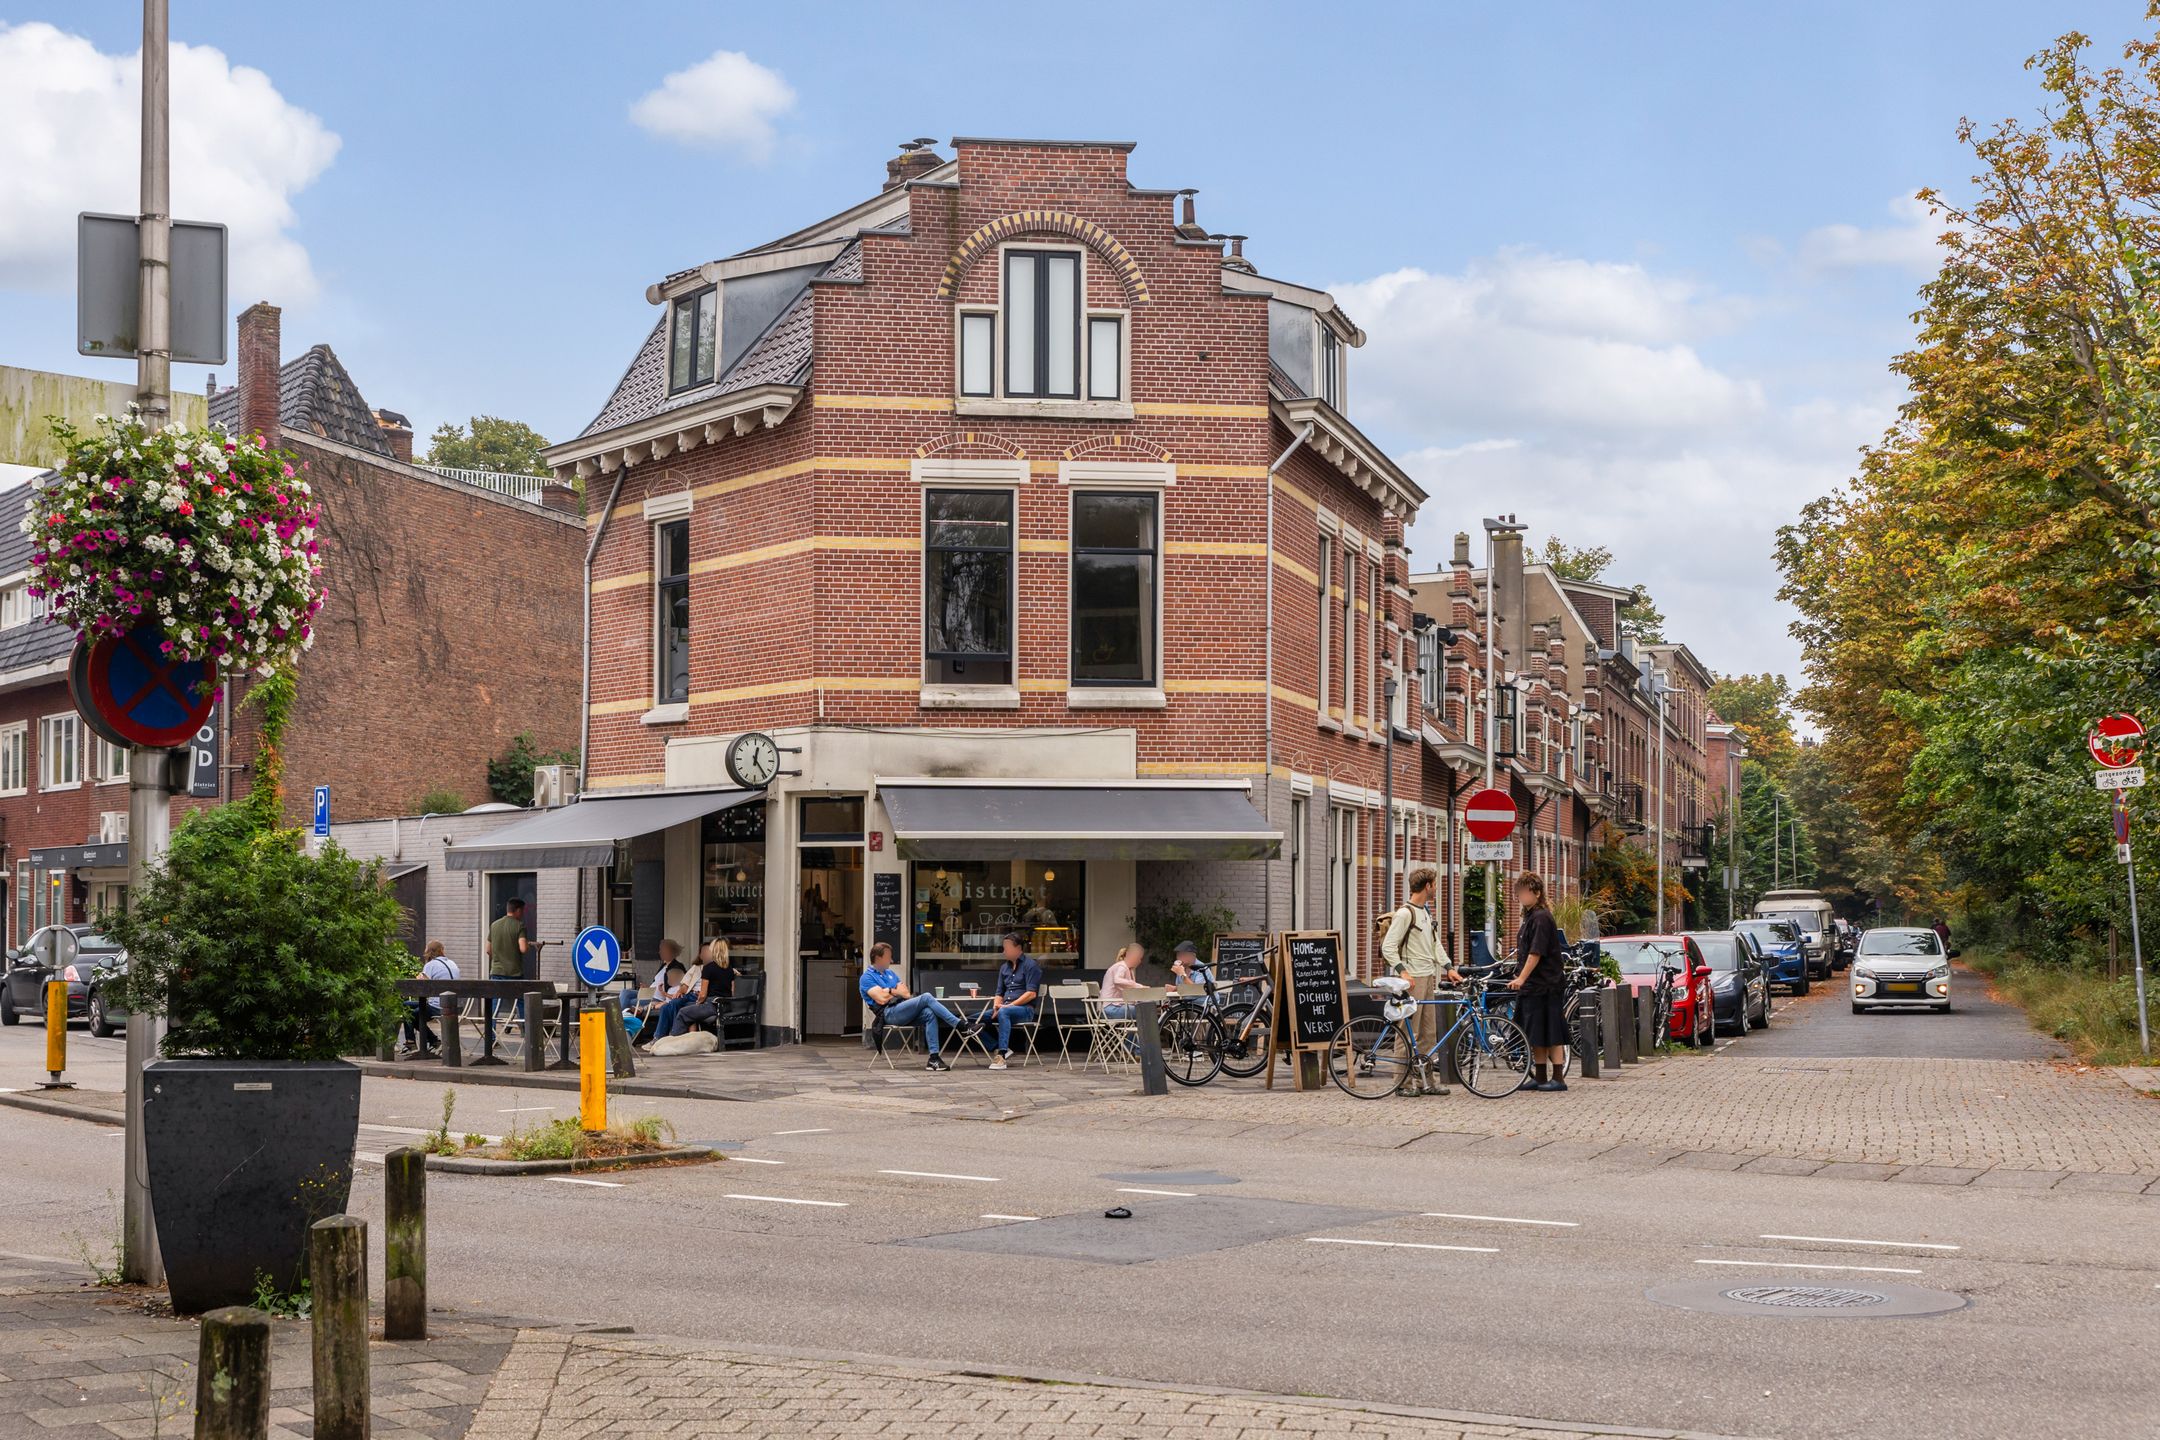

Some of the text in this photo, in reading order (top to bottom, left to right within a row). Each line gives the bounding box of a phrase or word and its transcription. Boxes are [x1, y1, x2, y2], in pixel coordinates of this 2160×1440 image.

[2098, 769, 2141, 778] uitgezonderd
[316, 791, 325, 816] P
[717, 881, 763, 898] district
[949, 881, 1047, 899] district
[1312, 1005, 1326, 1016] HET
[1304, 1021, 1334, 1035] VERST
